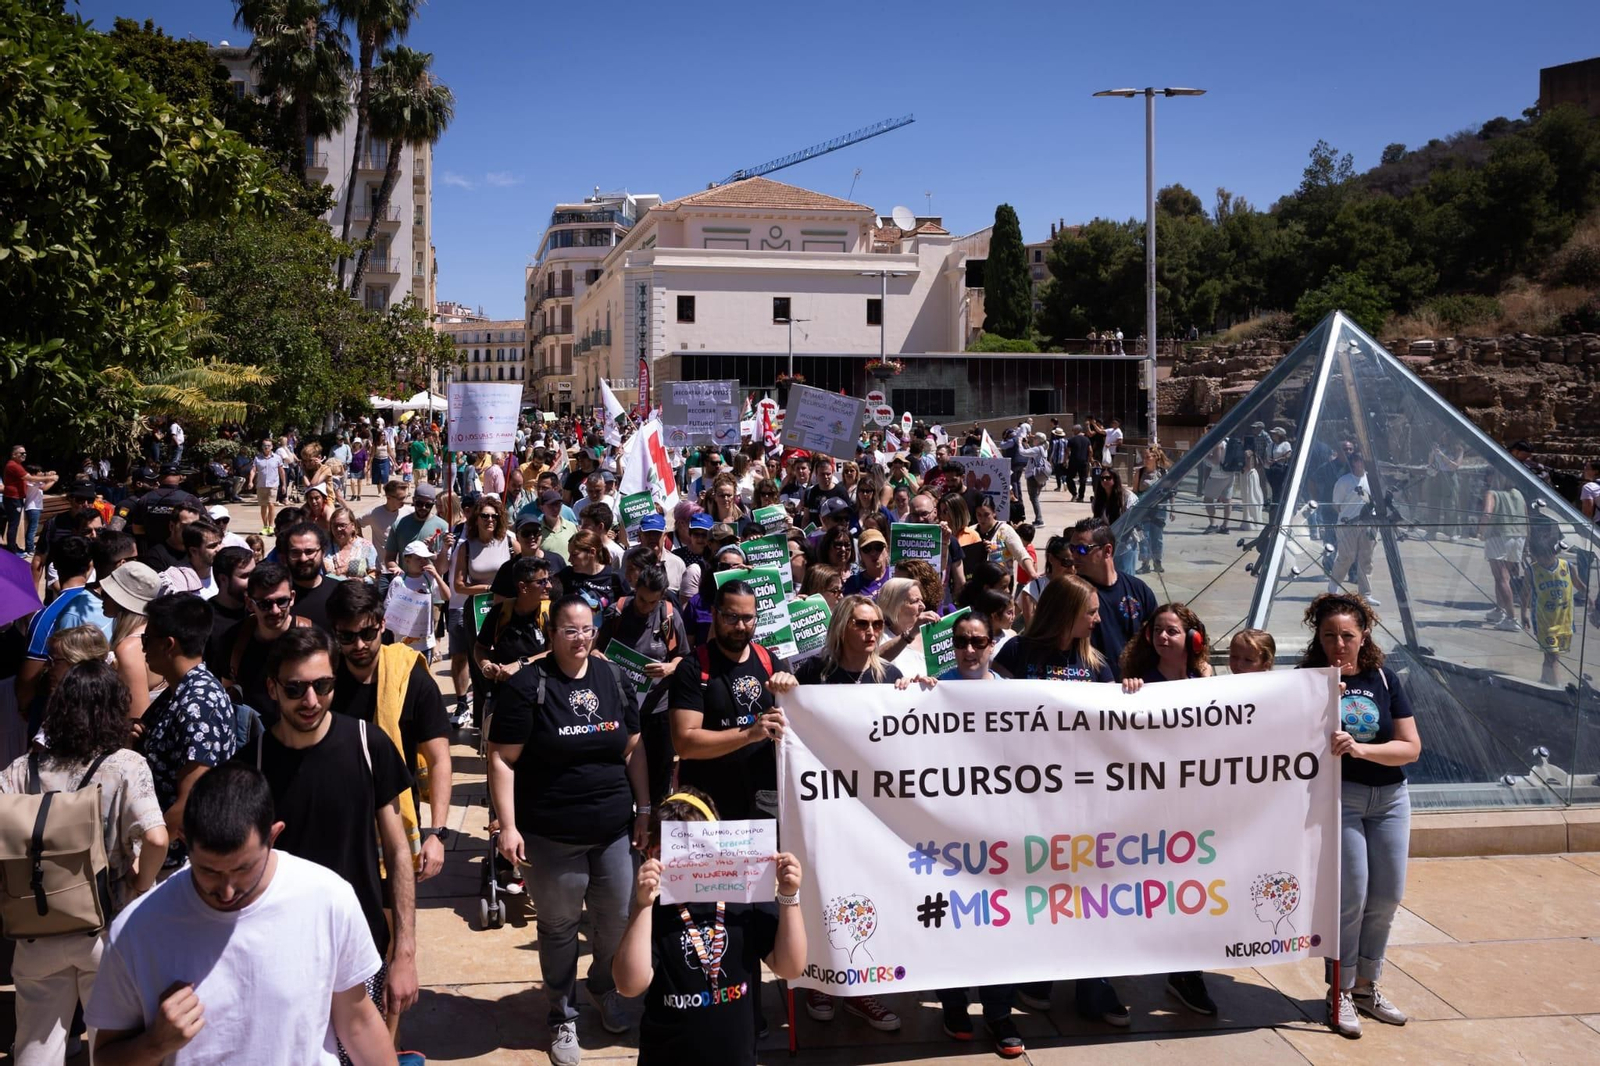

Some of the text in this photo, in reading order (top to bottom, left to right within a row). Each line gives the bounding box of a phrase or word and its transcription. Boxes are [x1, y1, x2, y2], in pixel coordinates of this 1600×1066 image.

[624, 501, 651, 513] EDUCACIÓN
[897, 539, 936, 549] EDUCACIÓN
[902, 548, 931, 558] PÚBLICA
[747, 549, 783, 561] EDUCACIÓN
[791, 610, 826, 630] DUCACIÓN
[795, 623, 827, 641] PÚBLICA
[1046, 664, 1090, 677] DERECHOS
[869, 700, 1256, 743] ¿DÓNDE ESTÁ LA INCLUSIÓN?
[800, 770, 858, 801] SIN
[873, 764, 1063, 799] RECURSOS
[1106, 761, 1165, 791] SIN
[1179, 751, 1319, 788] FUTURO
[908, 829, 1217, 876] #SUS DERECHOS
[917, 879, 1229, 929] #MIS PRINCIPIOS
